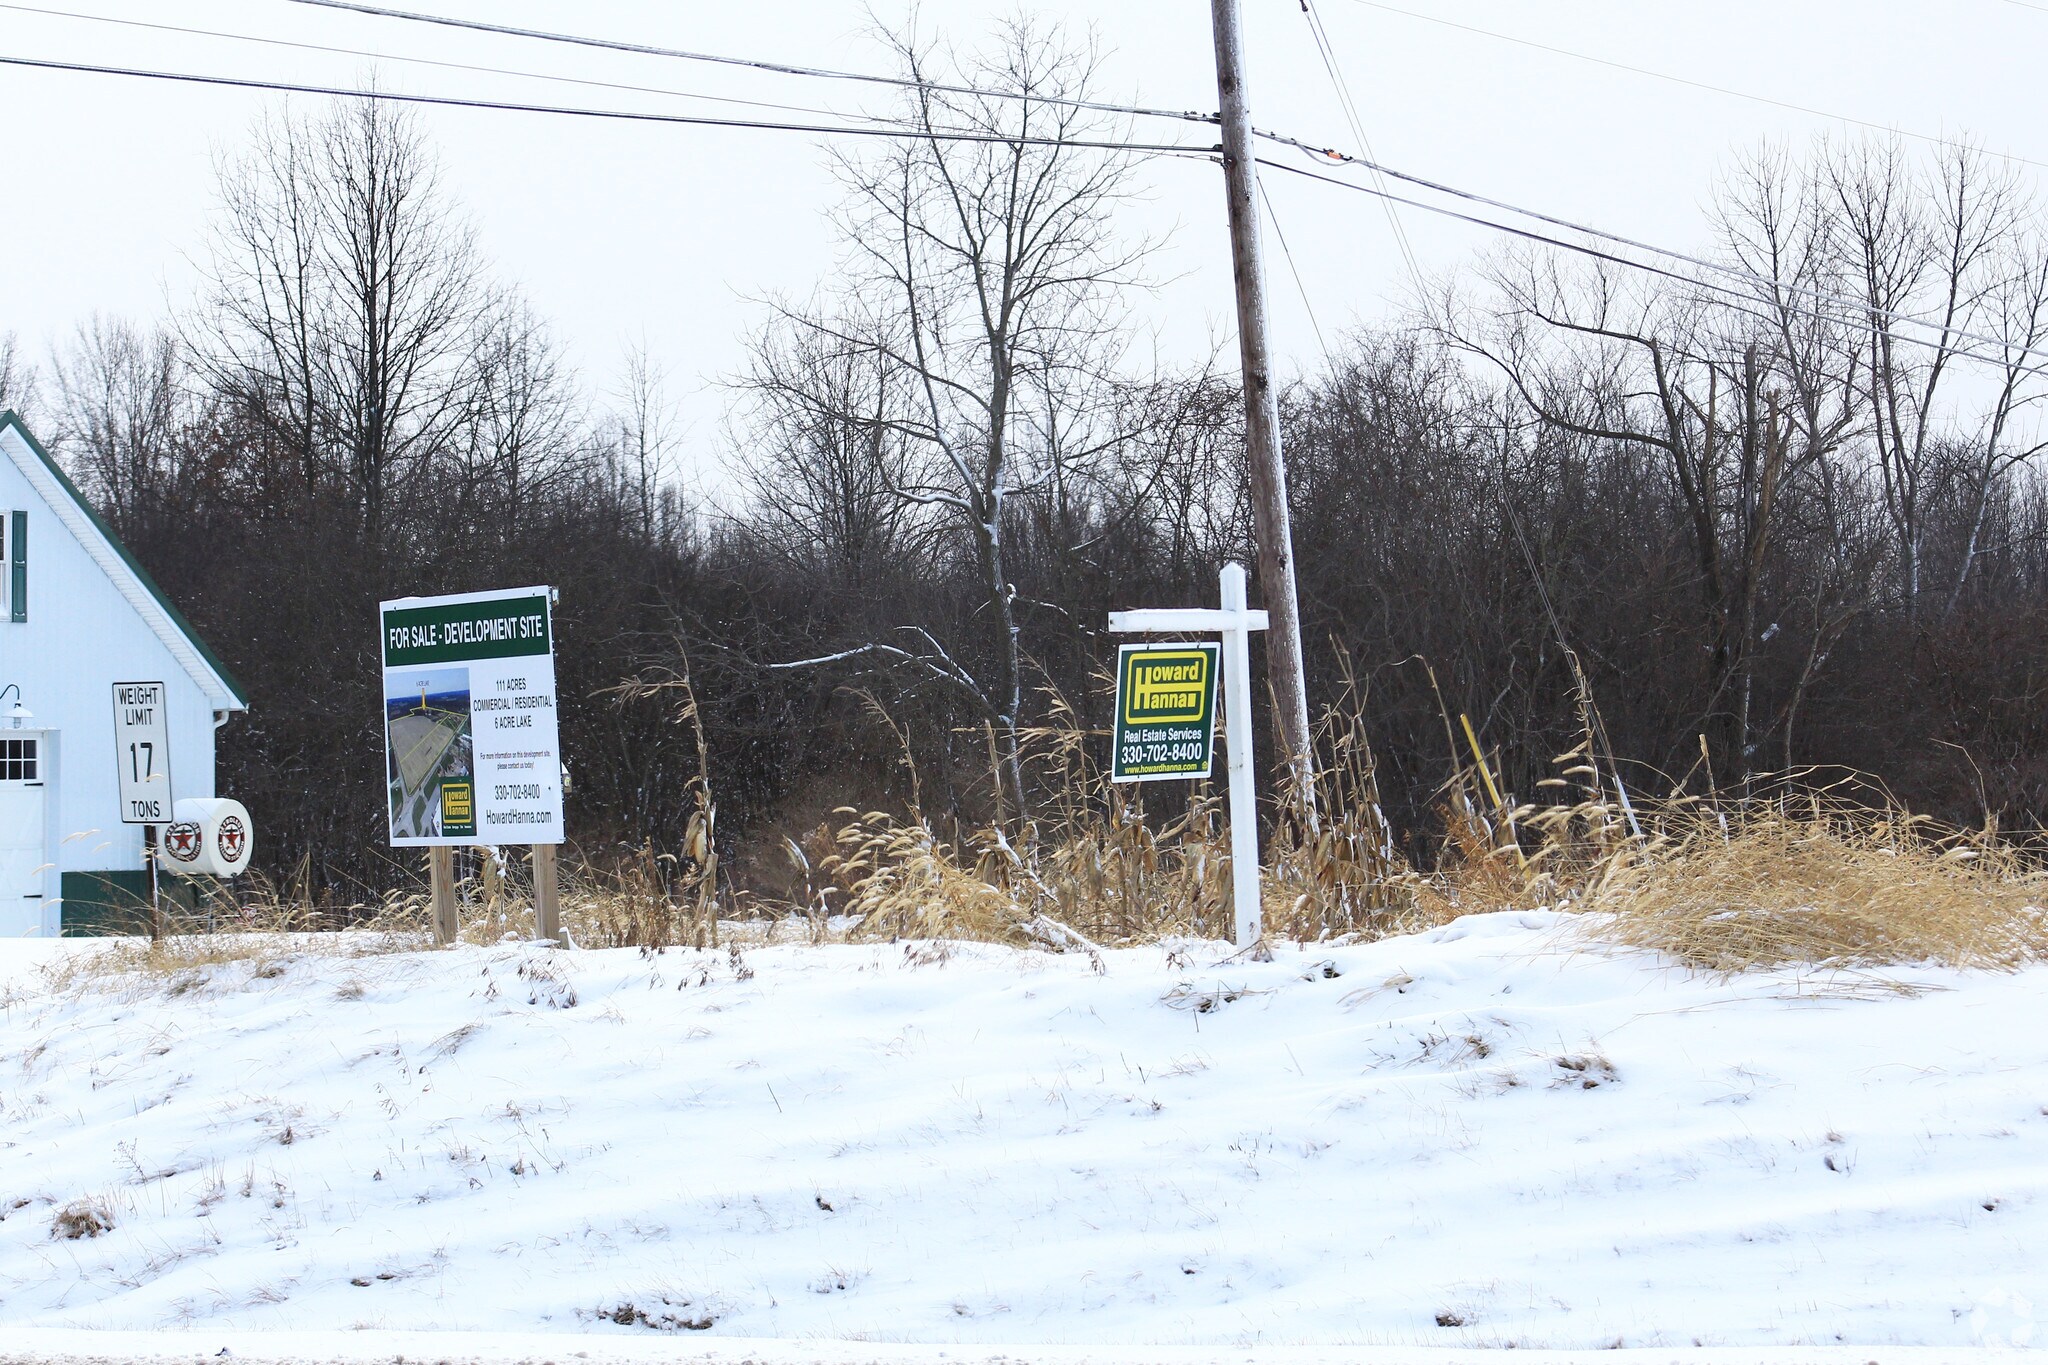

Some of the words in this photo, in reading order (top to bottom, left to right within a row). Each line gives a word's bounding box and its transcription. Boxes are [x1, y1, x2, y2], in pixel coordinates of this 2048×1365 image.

[390, 627, 410, 649] FOR
[412, 625, 437, 647] SALE
[444, 617, 518, 645] DEVELOPMENT
[520, 615, 543, 638] SITE
[1135, 661, 1199, 690] Howard
[496, 679, 506, 691] 111
[507, 678, 527, 691] ACRES
[118, 687, 158, 705] WEIGHT
[473, 698, 511, 711] COMMERCIAL
[515, 695, 552, 709] RESIDENTIAL
[1134, 684, 1191, 710] Hanna
[125, 709, 153, 725] LIMIT
[494, 717, 499, 729] 6
[500, 716, 515, 729] ACRE
[516, 715, 532, 727] LAKE
[1124, 729, 1141, 743] Real
[1142, 728, 1166, 743] Estate
[1168, 727, 1202, 741] Services
[1121, 743, 1203, 764] 330-702-8400
[130, 742, 153, 783] 17
[1124, 762, 1197, 774] www.howardhanna.com
[445, 789, 468, 803] Howard
[494, 784, 540, 800] 330-702-8400
[131, 801, 160, 818] TONS
[486, 808, 552, 825] HowardHanna.com
